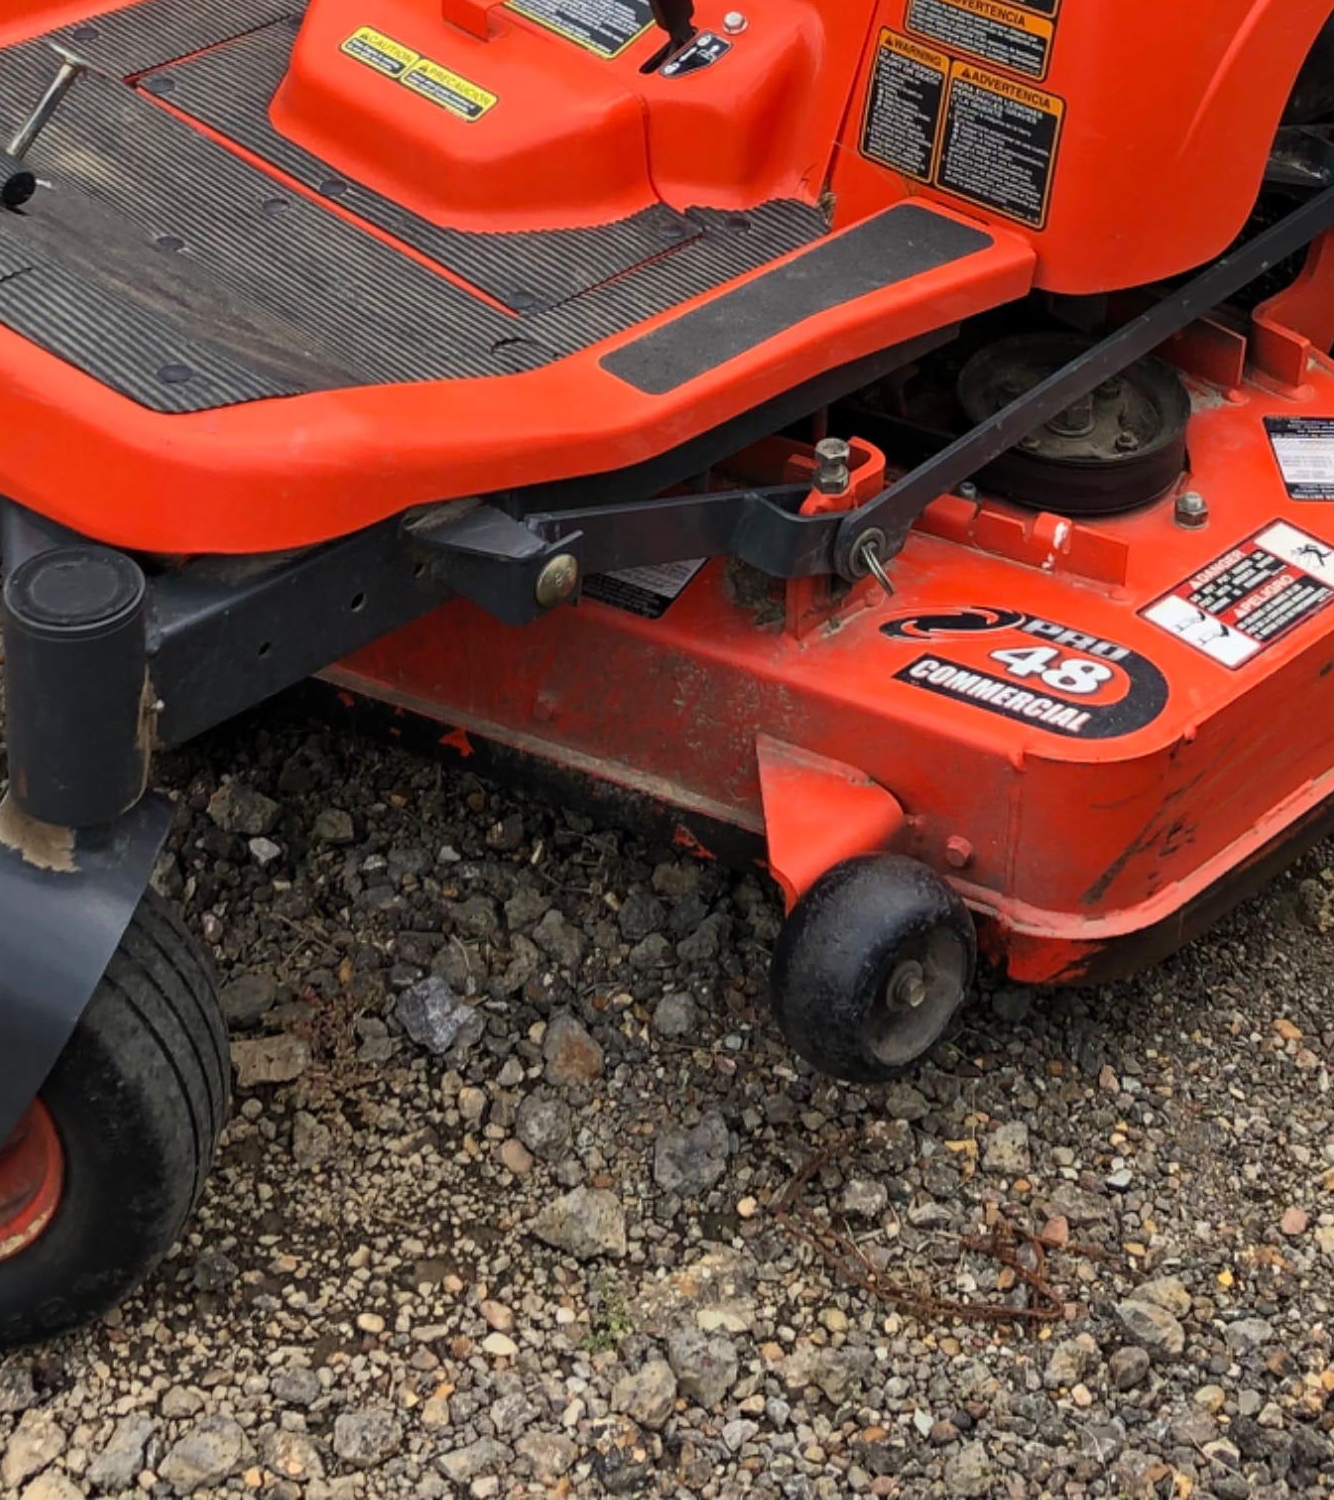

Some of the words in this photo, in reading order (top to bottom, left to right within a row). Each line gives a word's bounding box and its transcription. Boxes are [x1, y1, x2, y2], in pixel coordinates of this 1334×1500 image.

[368, 34, 413, 62] CAUTION
[894, 38, 941, 66] WARNING
[971, 72, 1051, 109] ADVERTENCIA
[1197, 549, 1246, 586] DANGER
[1242, 574, 1295, 615] PELIGRO
[1021, 618, 1132, 661] PRO
[990, 647, 1112, 694] 48
[910, 659, 1092, 732] COMMERCIAL
